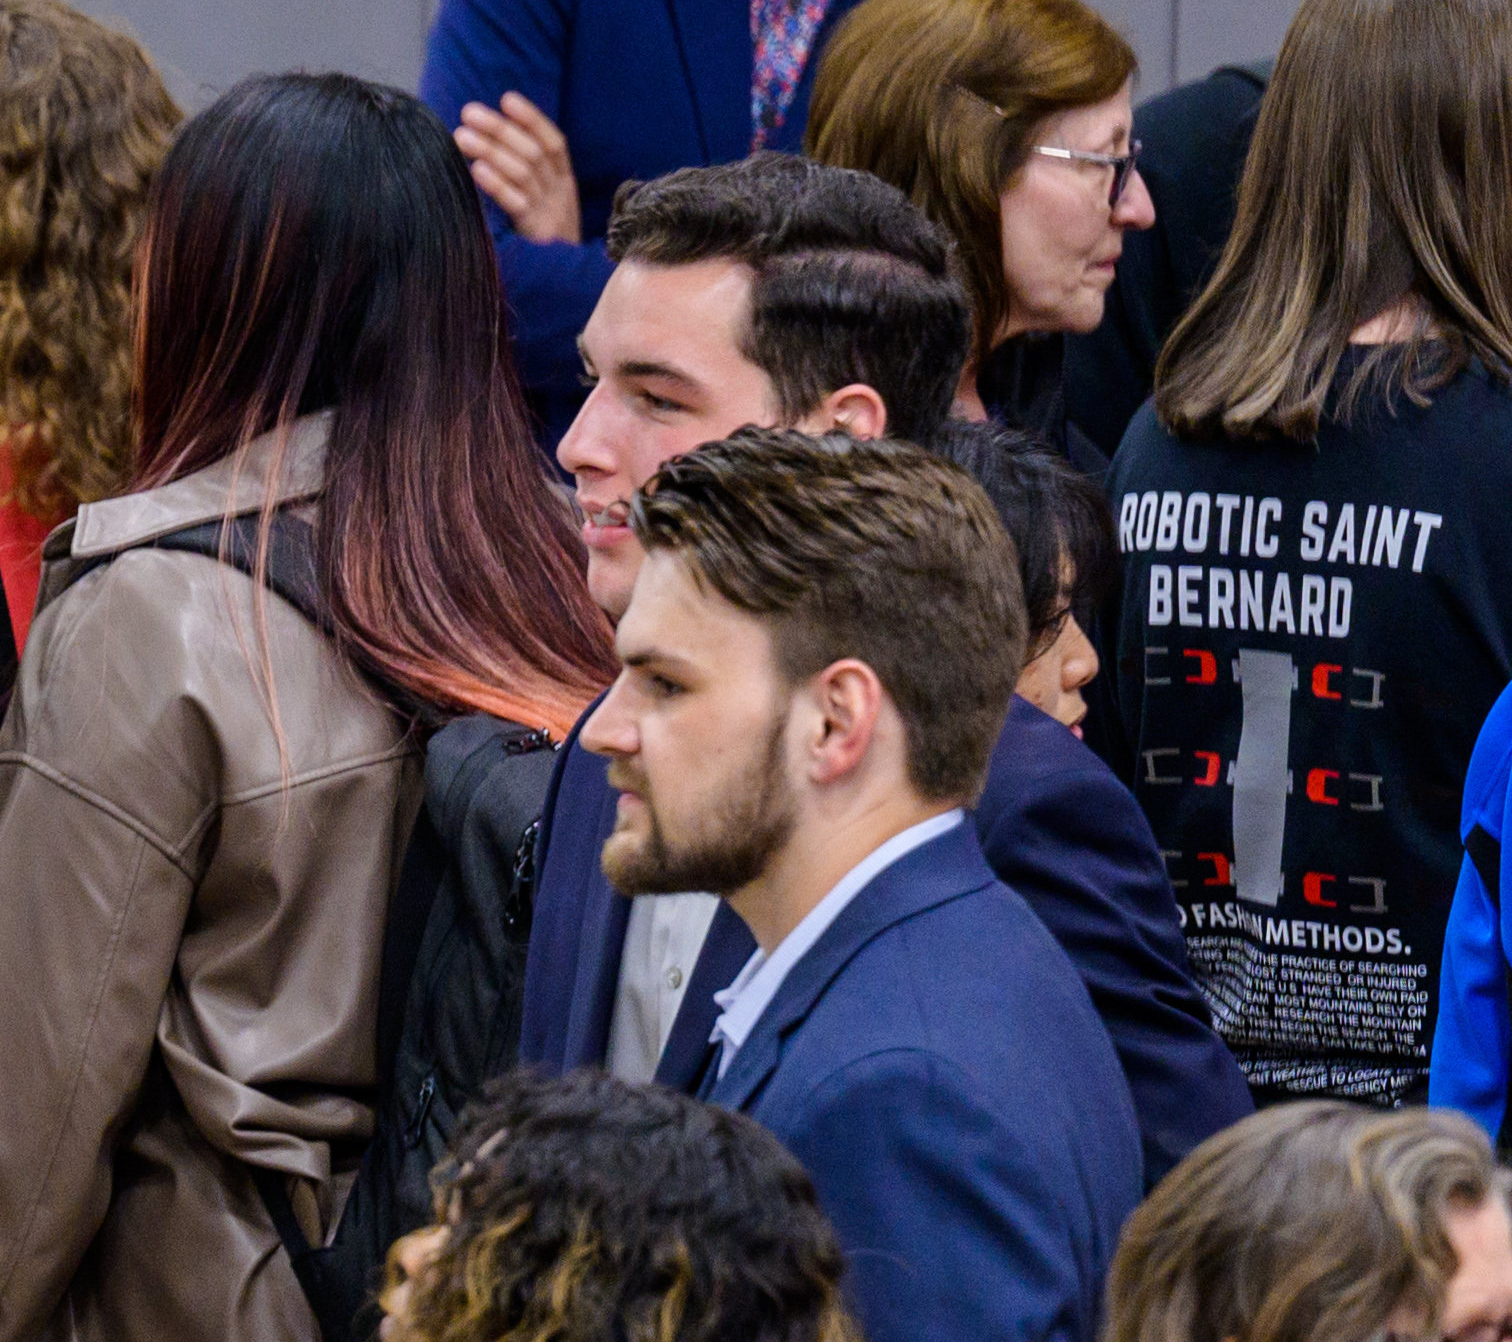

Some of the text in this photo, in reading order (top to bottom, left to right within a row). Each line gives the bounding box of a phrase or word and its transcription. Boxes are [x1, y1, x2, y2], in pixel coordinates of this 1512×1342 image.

[1119, 491, 1442, 573] ROBOTIC SAINT
[1148, 564, 1352, 638] BERNARD
[1266, 917, 1411, 955] METHODS.
